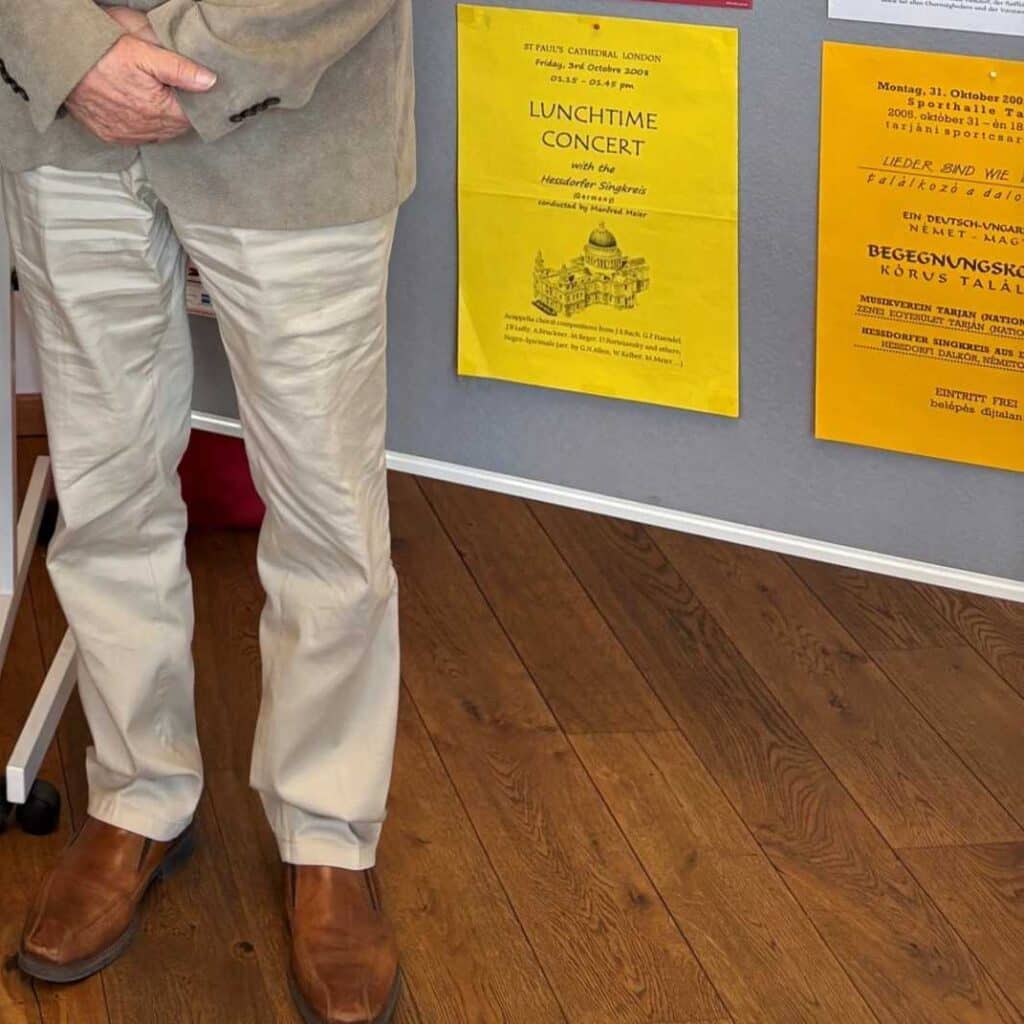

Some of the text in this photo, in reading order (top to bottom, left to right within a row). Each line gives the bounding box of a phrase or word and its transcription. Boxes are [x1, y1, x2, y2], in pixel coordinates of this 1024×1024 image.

[568, 46, 662, 63] CATHEDRAL LONDON
[877, 81, 1000, 103] Montag, Oktober
[529, 100, 658, 130] LUNCHTIME
[907, 98, 996, 115] Sporthalle
[542, 130, 645, 156] CONCERT
[571, 160, 615, 174] with the
[883, 155, 933, 171] LIEDER
[985, 168, 1010, 181] WIE
[541, 175, 647, 196] Hessdorfer Singkreis
[868, 244, 1024, 279] BEGEGNUNGSKO
[935, 387, 1018, 408] EINTRITT FREI
